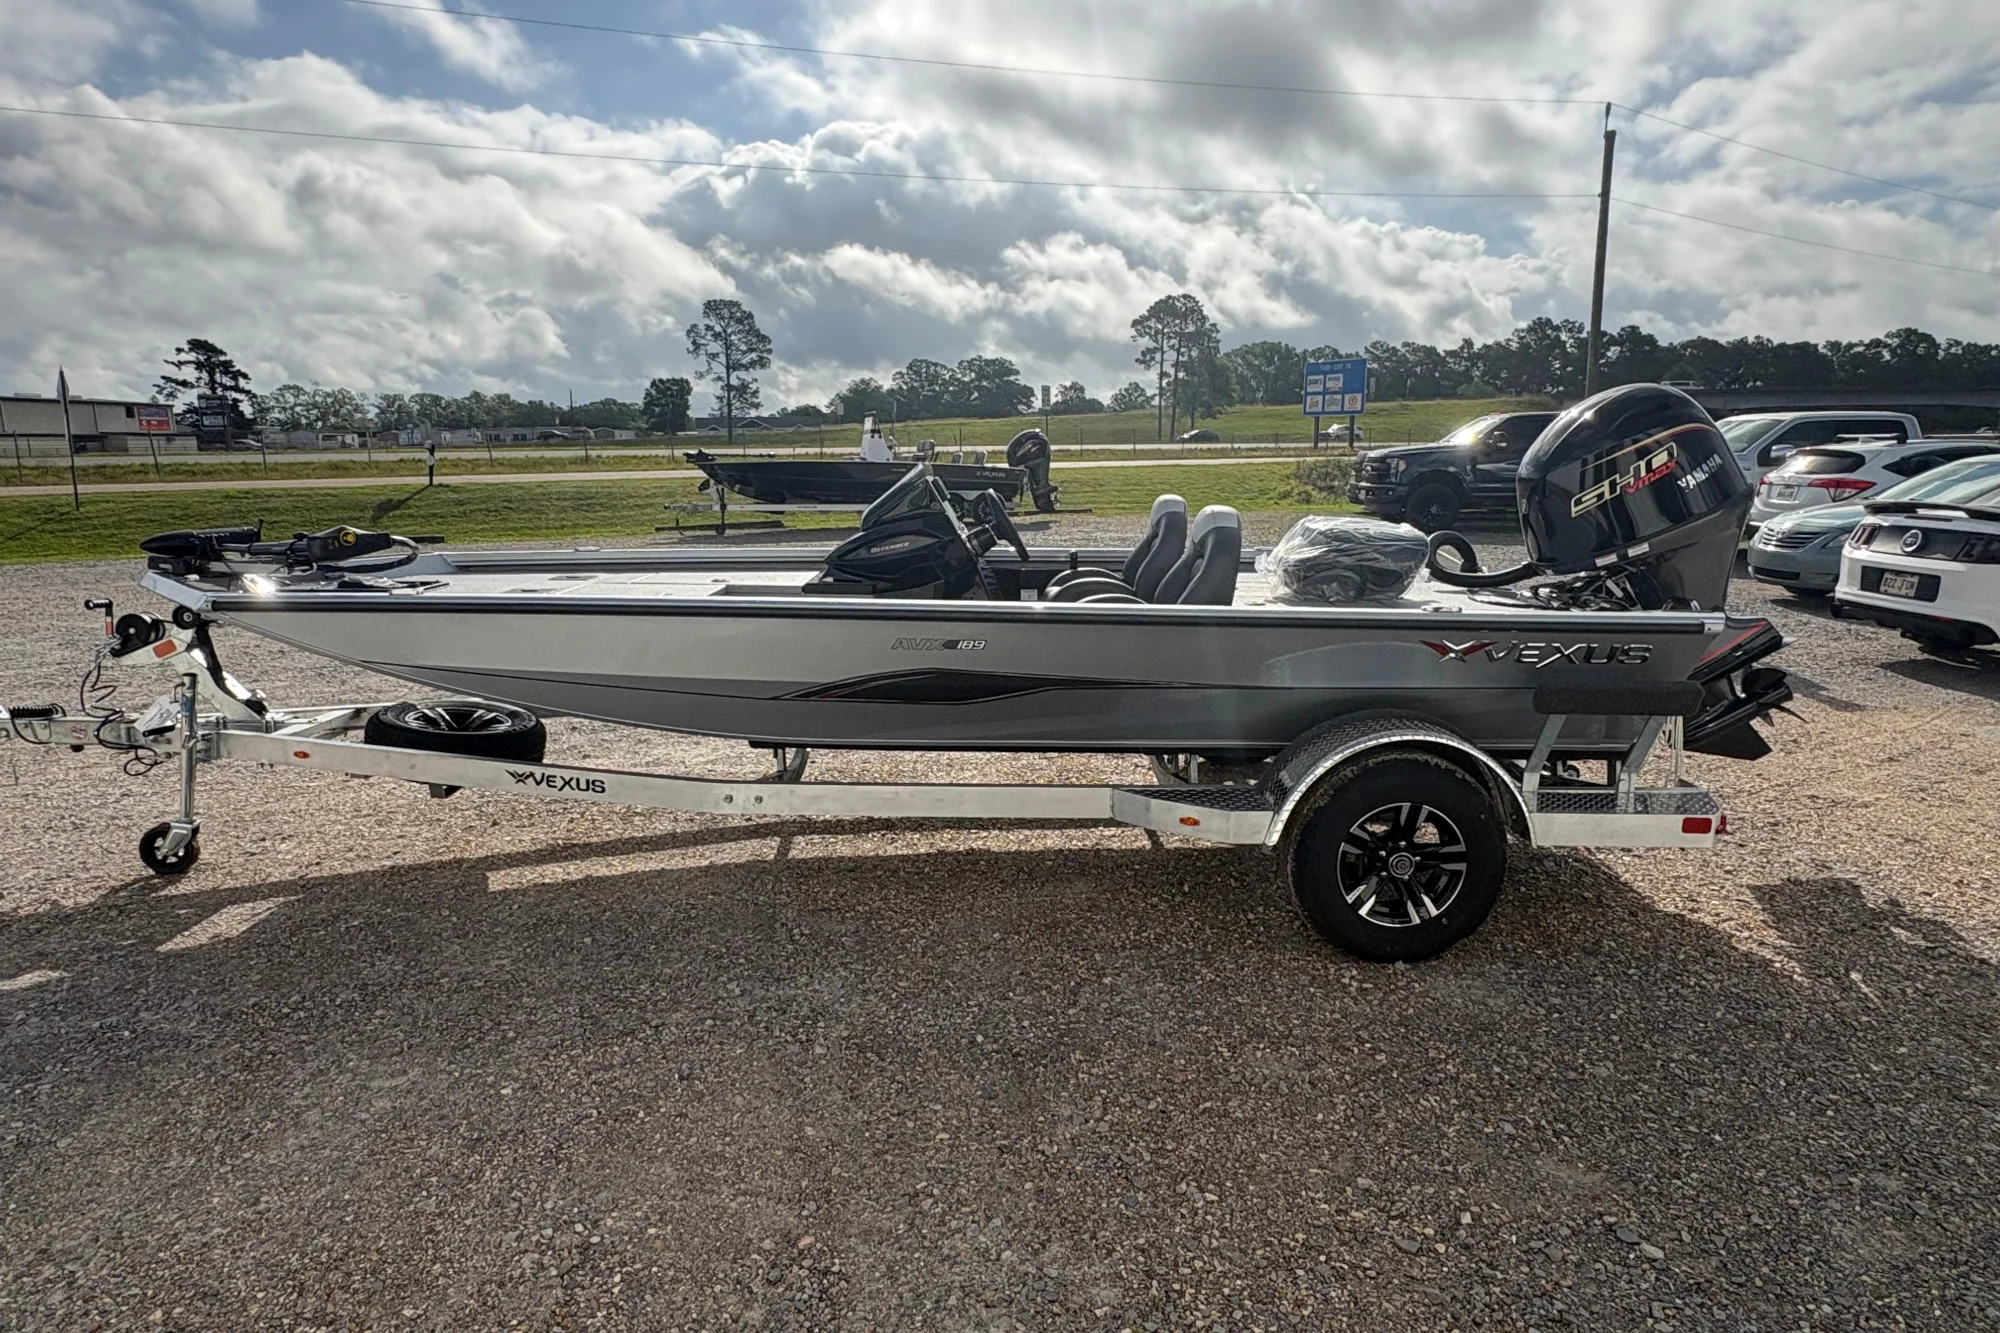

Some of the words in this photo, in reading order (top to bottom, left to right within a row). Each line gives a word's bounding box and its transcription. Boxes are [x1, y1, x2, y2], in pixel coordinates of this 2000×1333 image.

[1571, 441, 1678, 518] SHO
[1677, 453, 1723, 493] YAMAHA
[891, 637, 946, 650] AVX
[957, 640, 986, 650] 189
[1481, 639, 1654, 668] VEXUS
[529, 771, 606, 794] VEXUS
